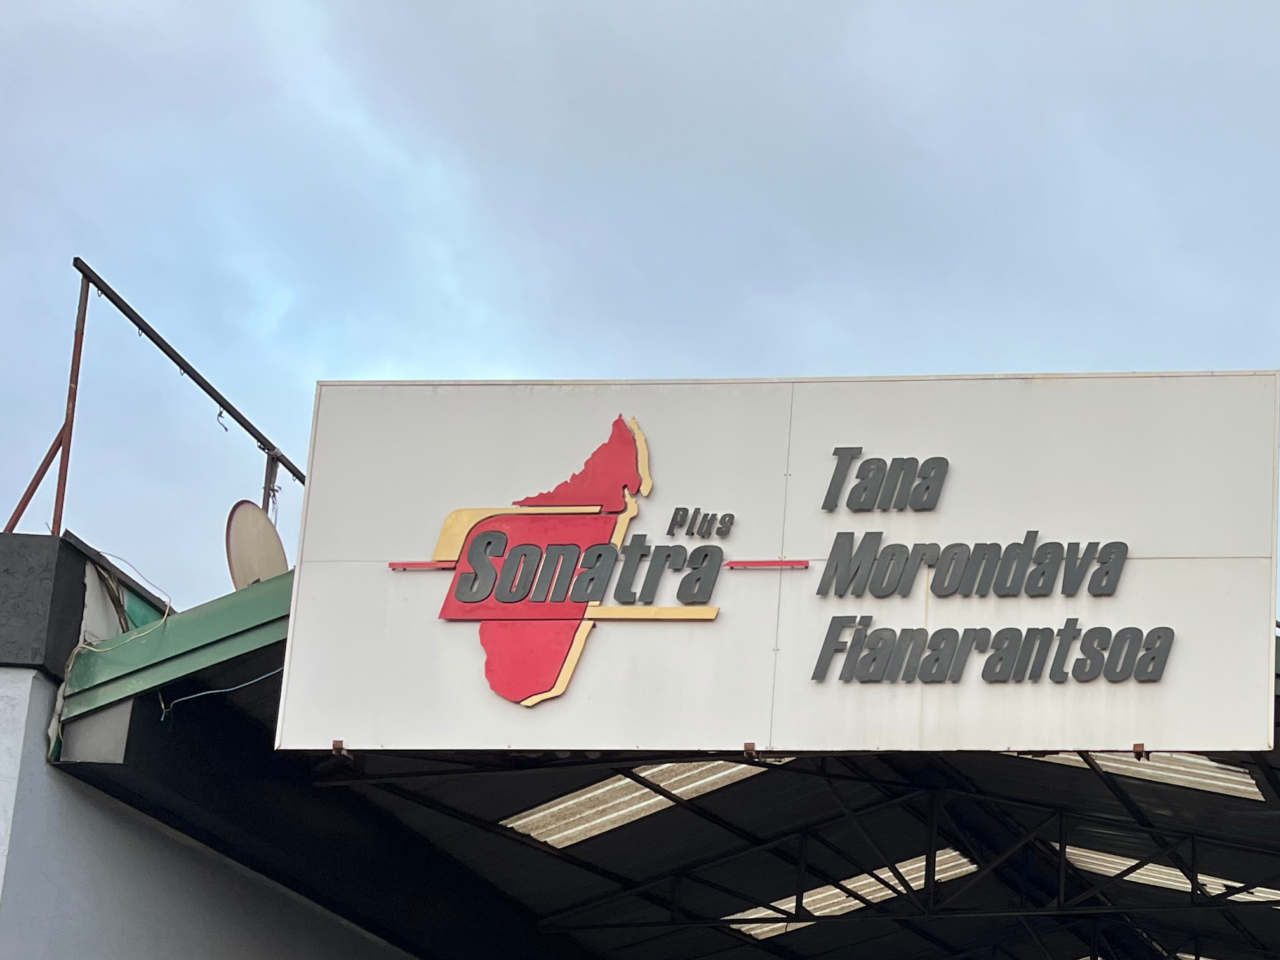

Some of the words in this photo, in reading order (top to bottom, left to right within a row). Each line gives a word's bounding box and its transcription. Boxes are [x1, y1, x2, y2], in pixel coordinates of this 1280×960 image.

[821, 446, 949, 513] Tana
[666, 507, 735, 539] Plus
[455, 530, 724, 605] Sonatra
[815, 530, 1129, 598] Morondava
[811, 615, 1175, 684] Fianarantsoa
